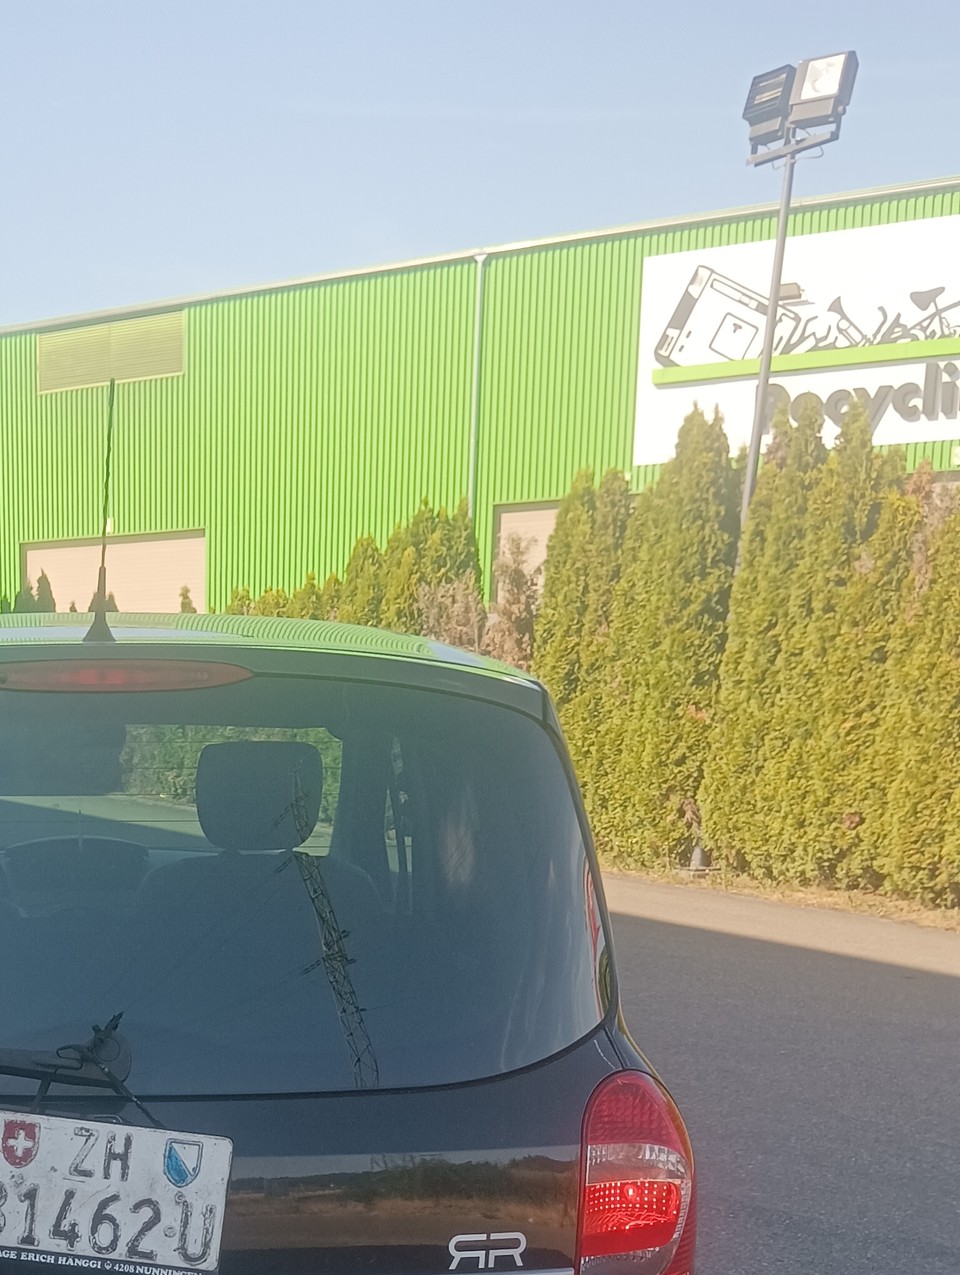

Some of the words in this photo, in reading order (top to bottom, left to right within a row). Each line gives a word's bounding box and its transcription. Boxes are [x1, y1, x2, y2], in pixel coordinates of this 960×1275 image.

[757, 362, 959, 432] cycli
[69, 1126, 134, 1182] ZH
[20, 1252, 55, 1265] ERICH
[57, 1255, 102, 1270] HÄNGGI
[113, 1263, 135, 1274] 4208
